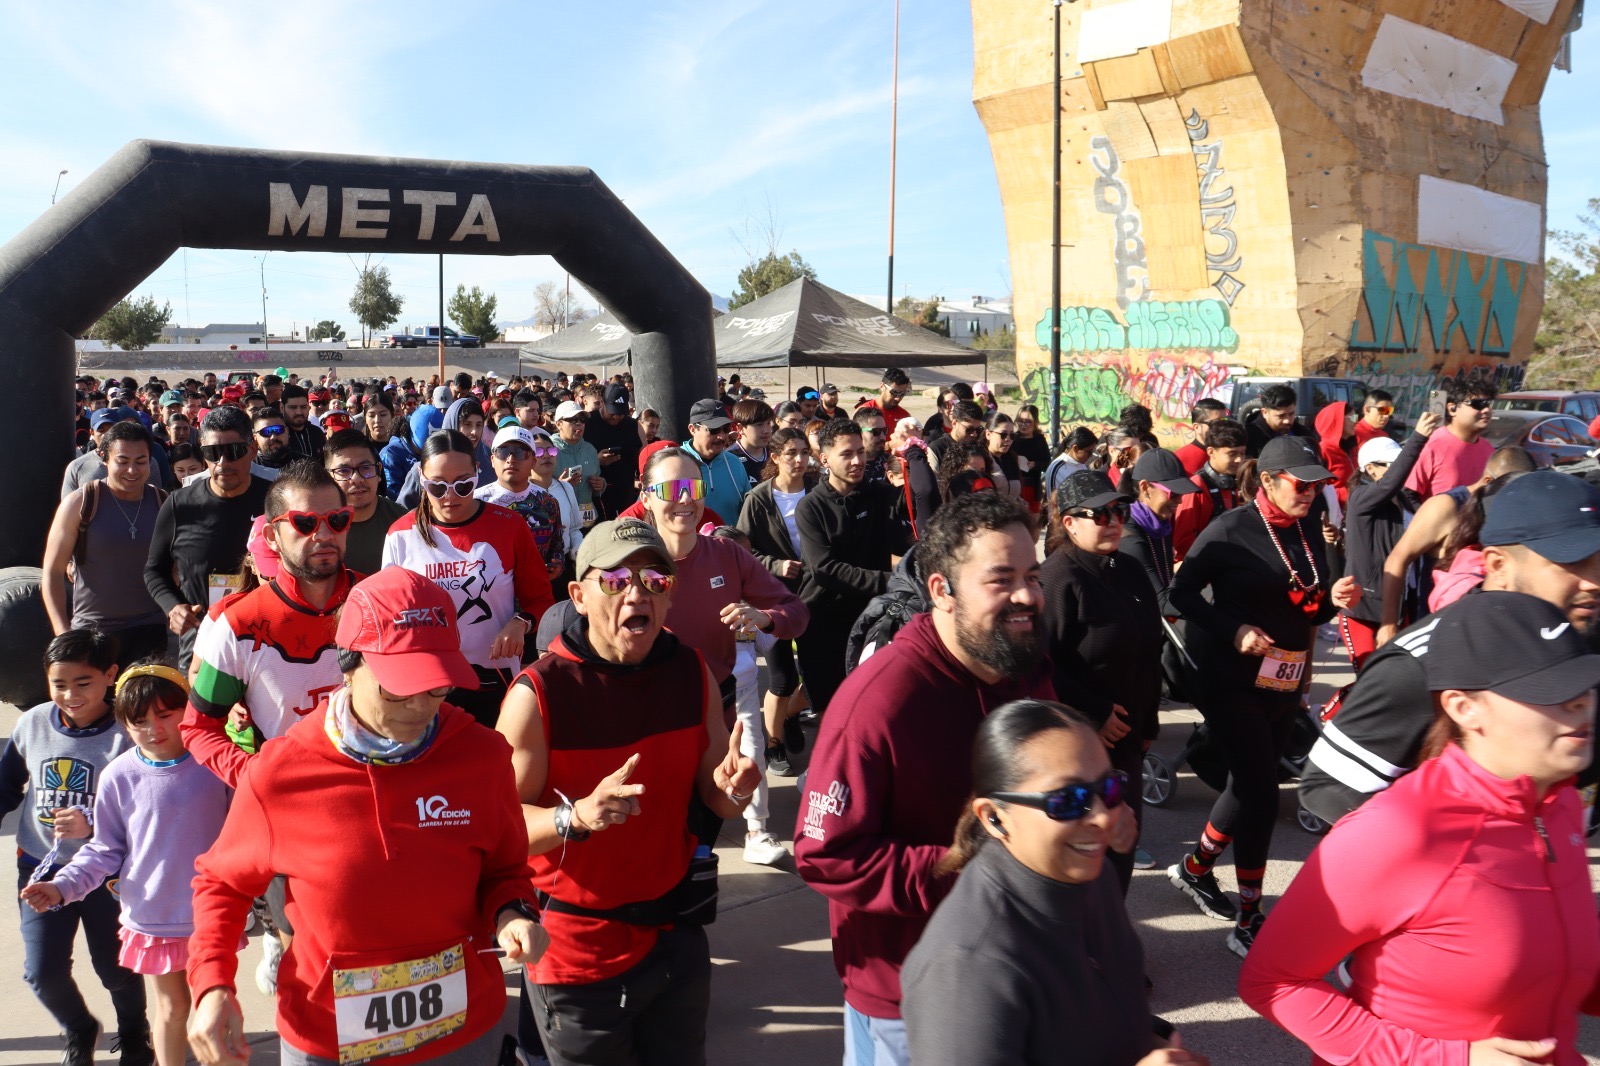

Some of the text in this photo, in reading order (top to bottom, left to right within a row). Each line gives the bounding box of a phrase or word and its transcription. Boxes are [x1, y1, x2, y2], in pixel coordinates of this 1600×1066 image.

[267, 182, 501, 242] META
[725, 310, 796, 330] POWER
[811, 314, 895, 330] POWER
[1275, 662, 1303, 681] 831
[441, 809, 471, 819] EDICIÓN
[418, 820, 443, 828] CARRERA
[364, 983, 443, 1034] 408
